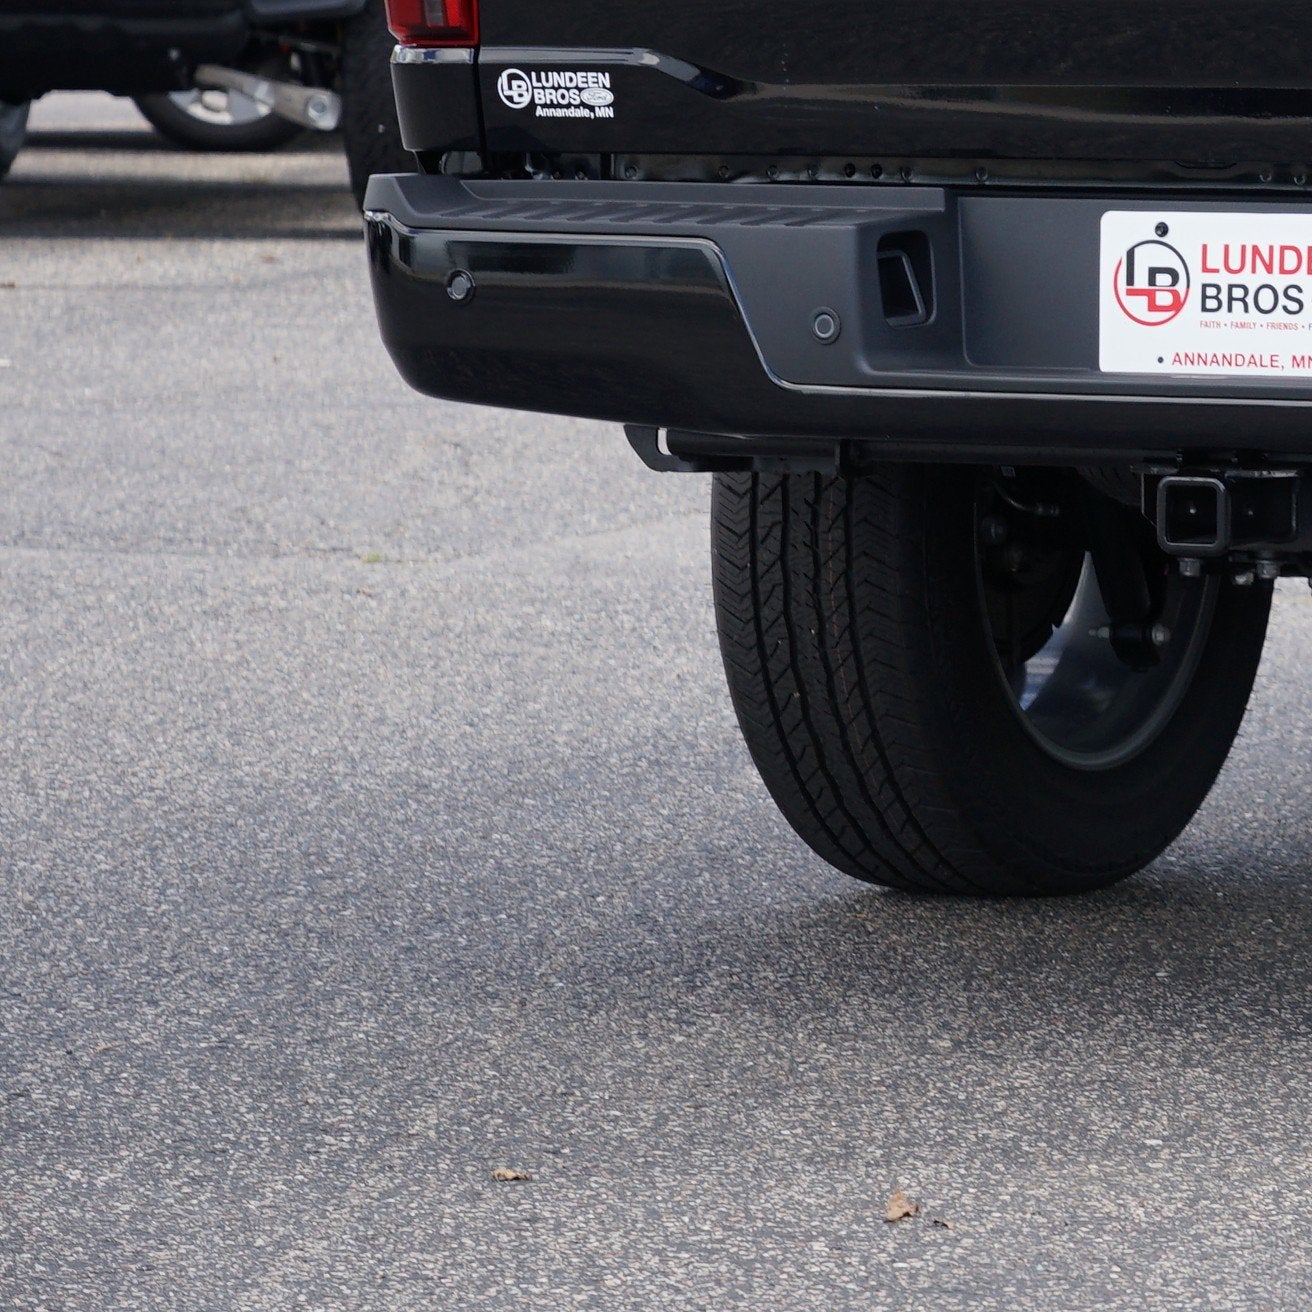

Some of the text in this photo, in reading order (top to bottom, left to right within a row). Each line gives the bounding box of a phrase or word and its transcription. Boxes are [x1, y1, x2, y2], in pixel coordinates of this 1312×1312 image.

[531, 72, 611, 88] LUNDEEN
[533, 89, 581, 105] BROS
[535, 106, 614, 119] Annandale, MN
[1201, 283, 1304, 315] BROS
[1200, 320, 1221, 329] FAITH
[1230, 321, 1257, 330] FAMILY
[1266, 322, 1299, 331] FRIENDS
[1171, 352, 1285, 371] ANNANDALE,
